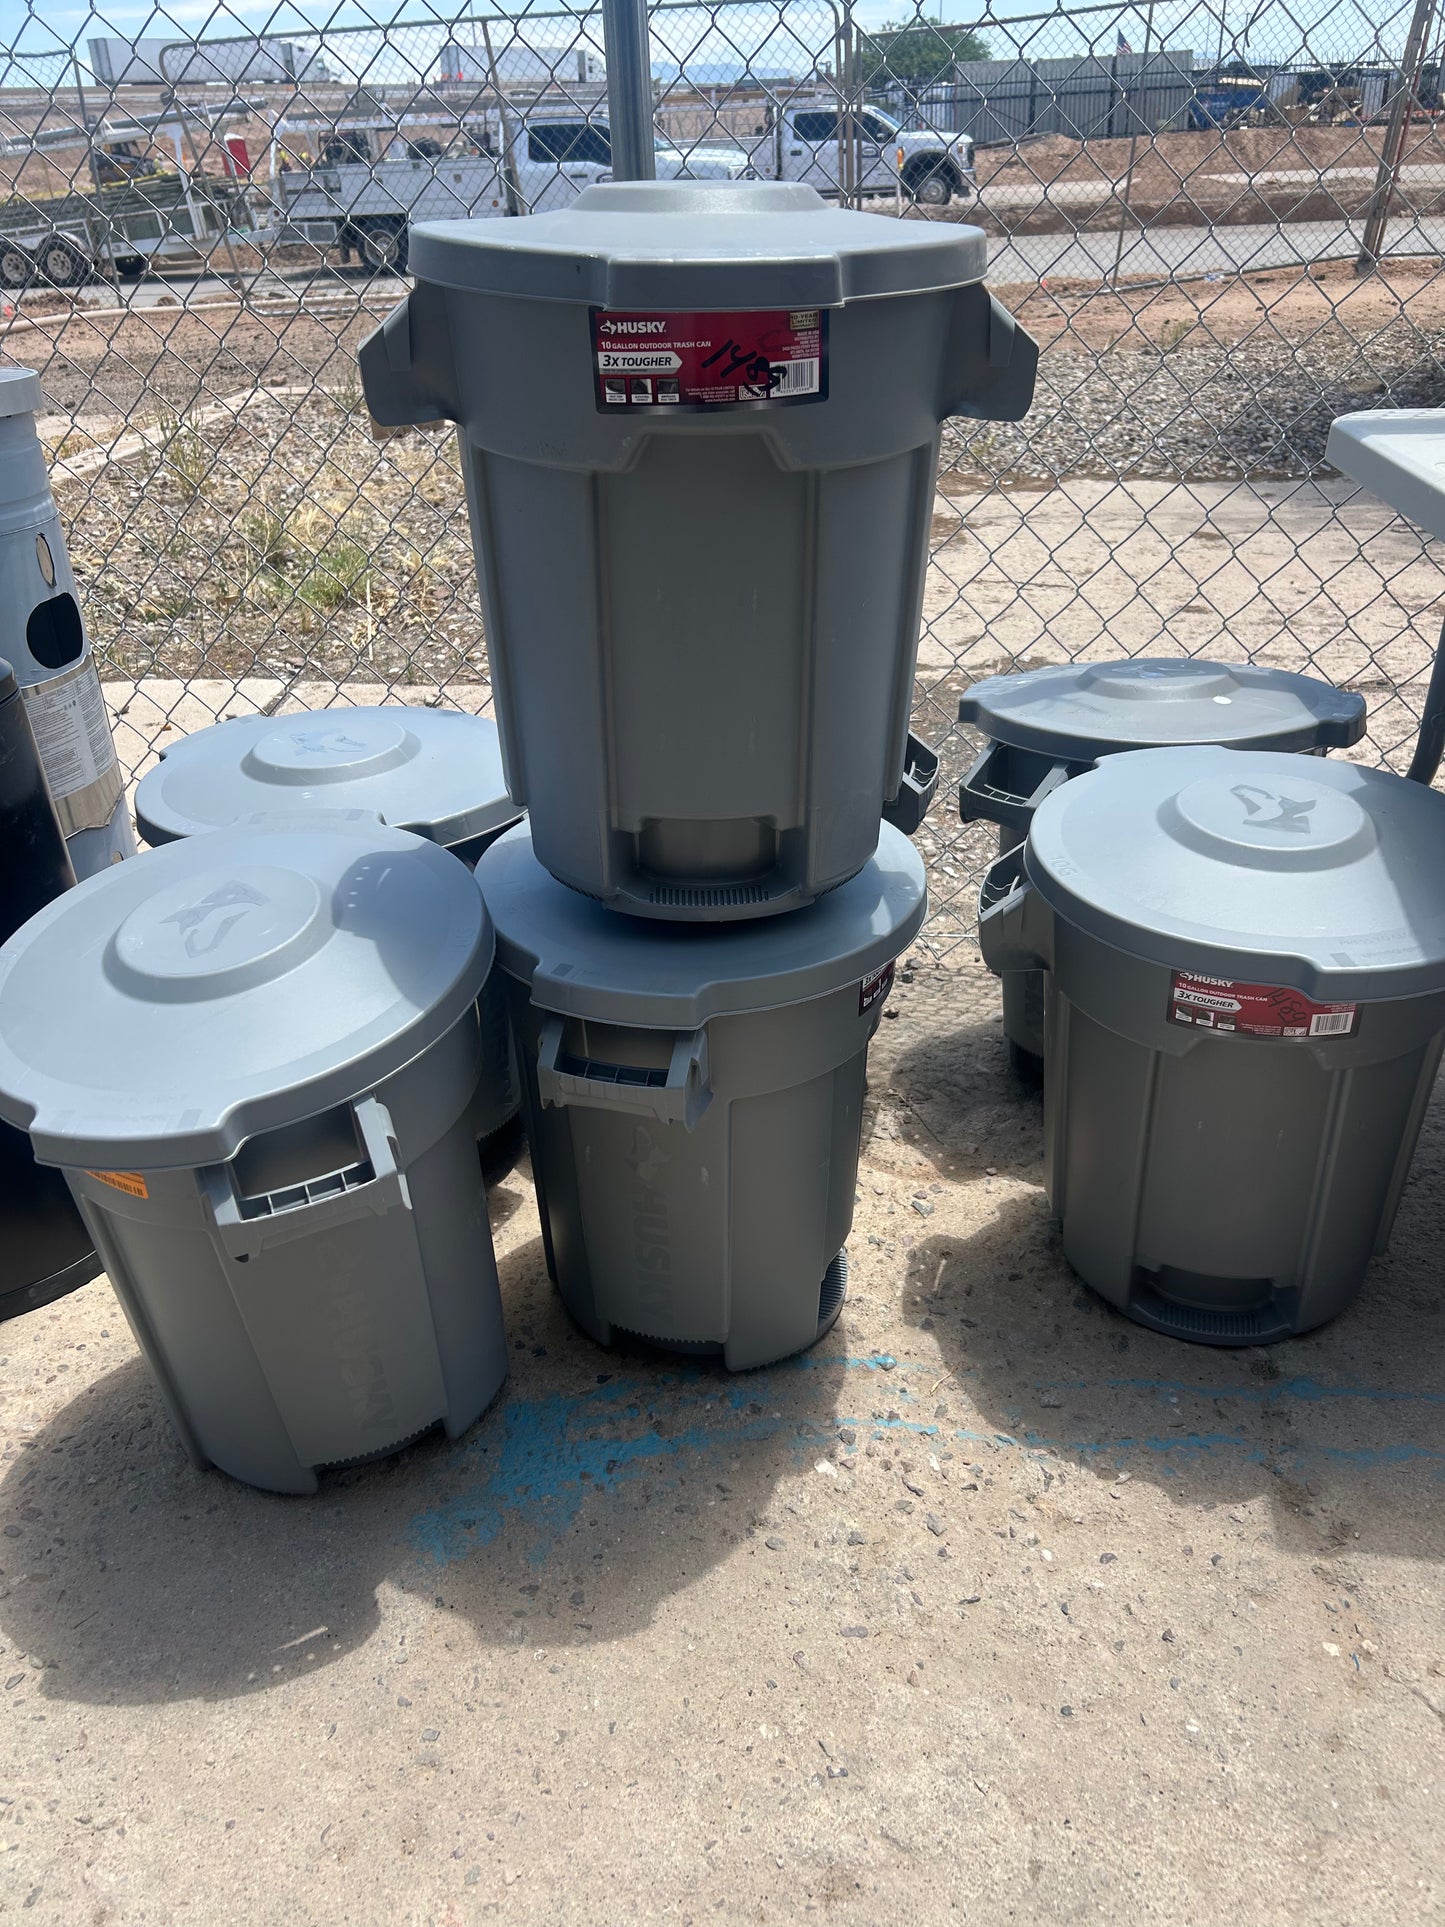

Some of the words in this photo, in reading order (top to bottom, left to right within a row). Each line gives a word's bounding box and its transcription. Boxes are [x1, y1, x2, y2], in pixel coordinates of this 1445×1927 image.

[616, 321, 666, 334] HUSKY
[601, 341, 611, 350] 10
[612, 342, 639, 350] GALLON
[639, 342, 672, 350] OUTDOOR
[673, 341, 695, 349] TRASH
[603, 355, 620, 367] 3X
[621, 357, 672, 367] TOUGHER
[1193, 975, 1233, 988] HUSKY
[1187, 986, 1209, 994] GALLON
[1209, 990, 1236, 998] OUTDOOR
[1177, 990, 1191, 1001] 3X
[1193, 995, 1234, 1009] TOUGHER
